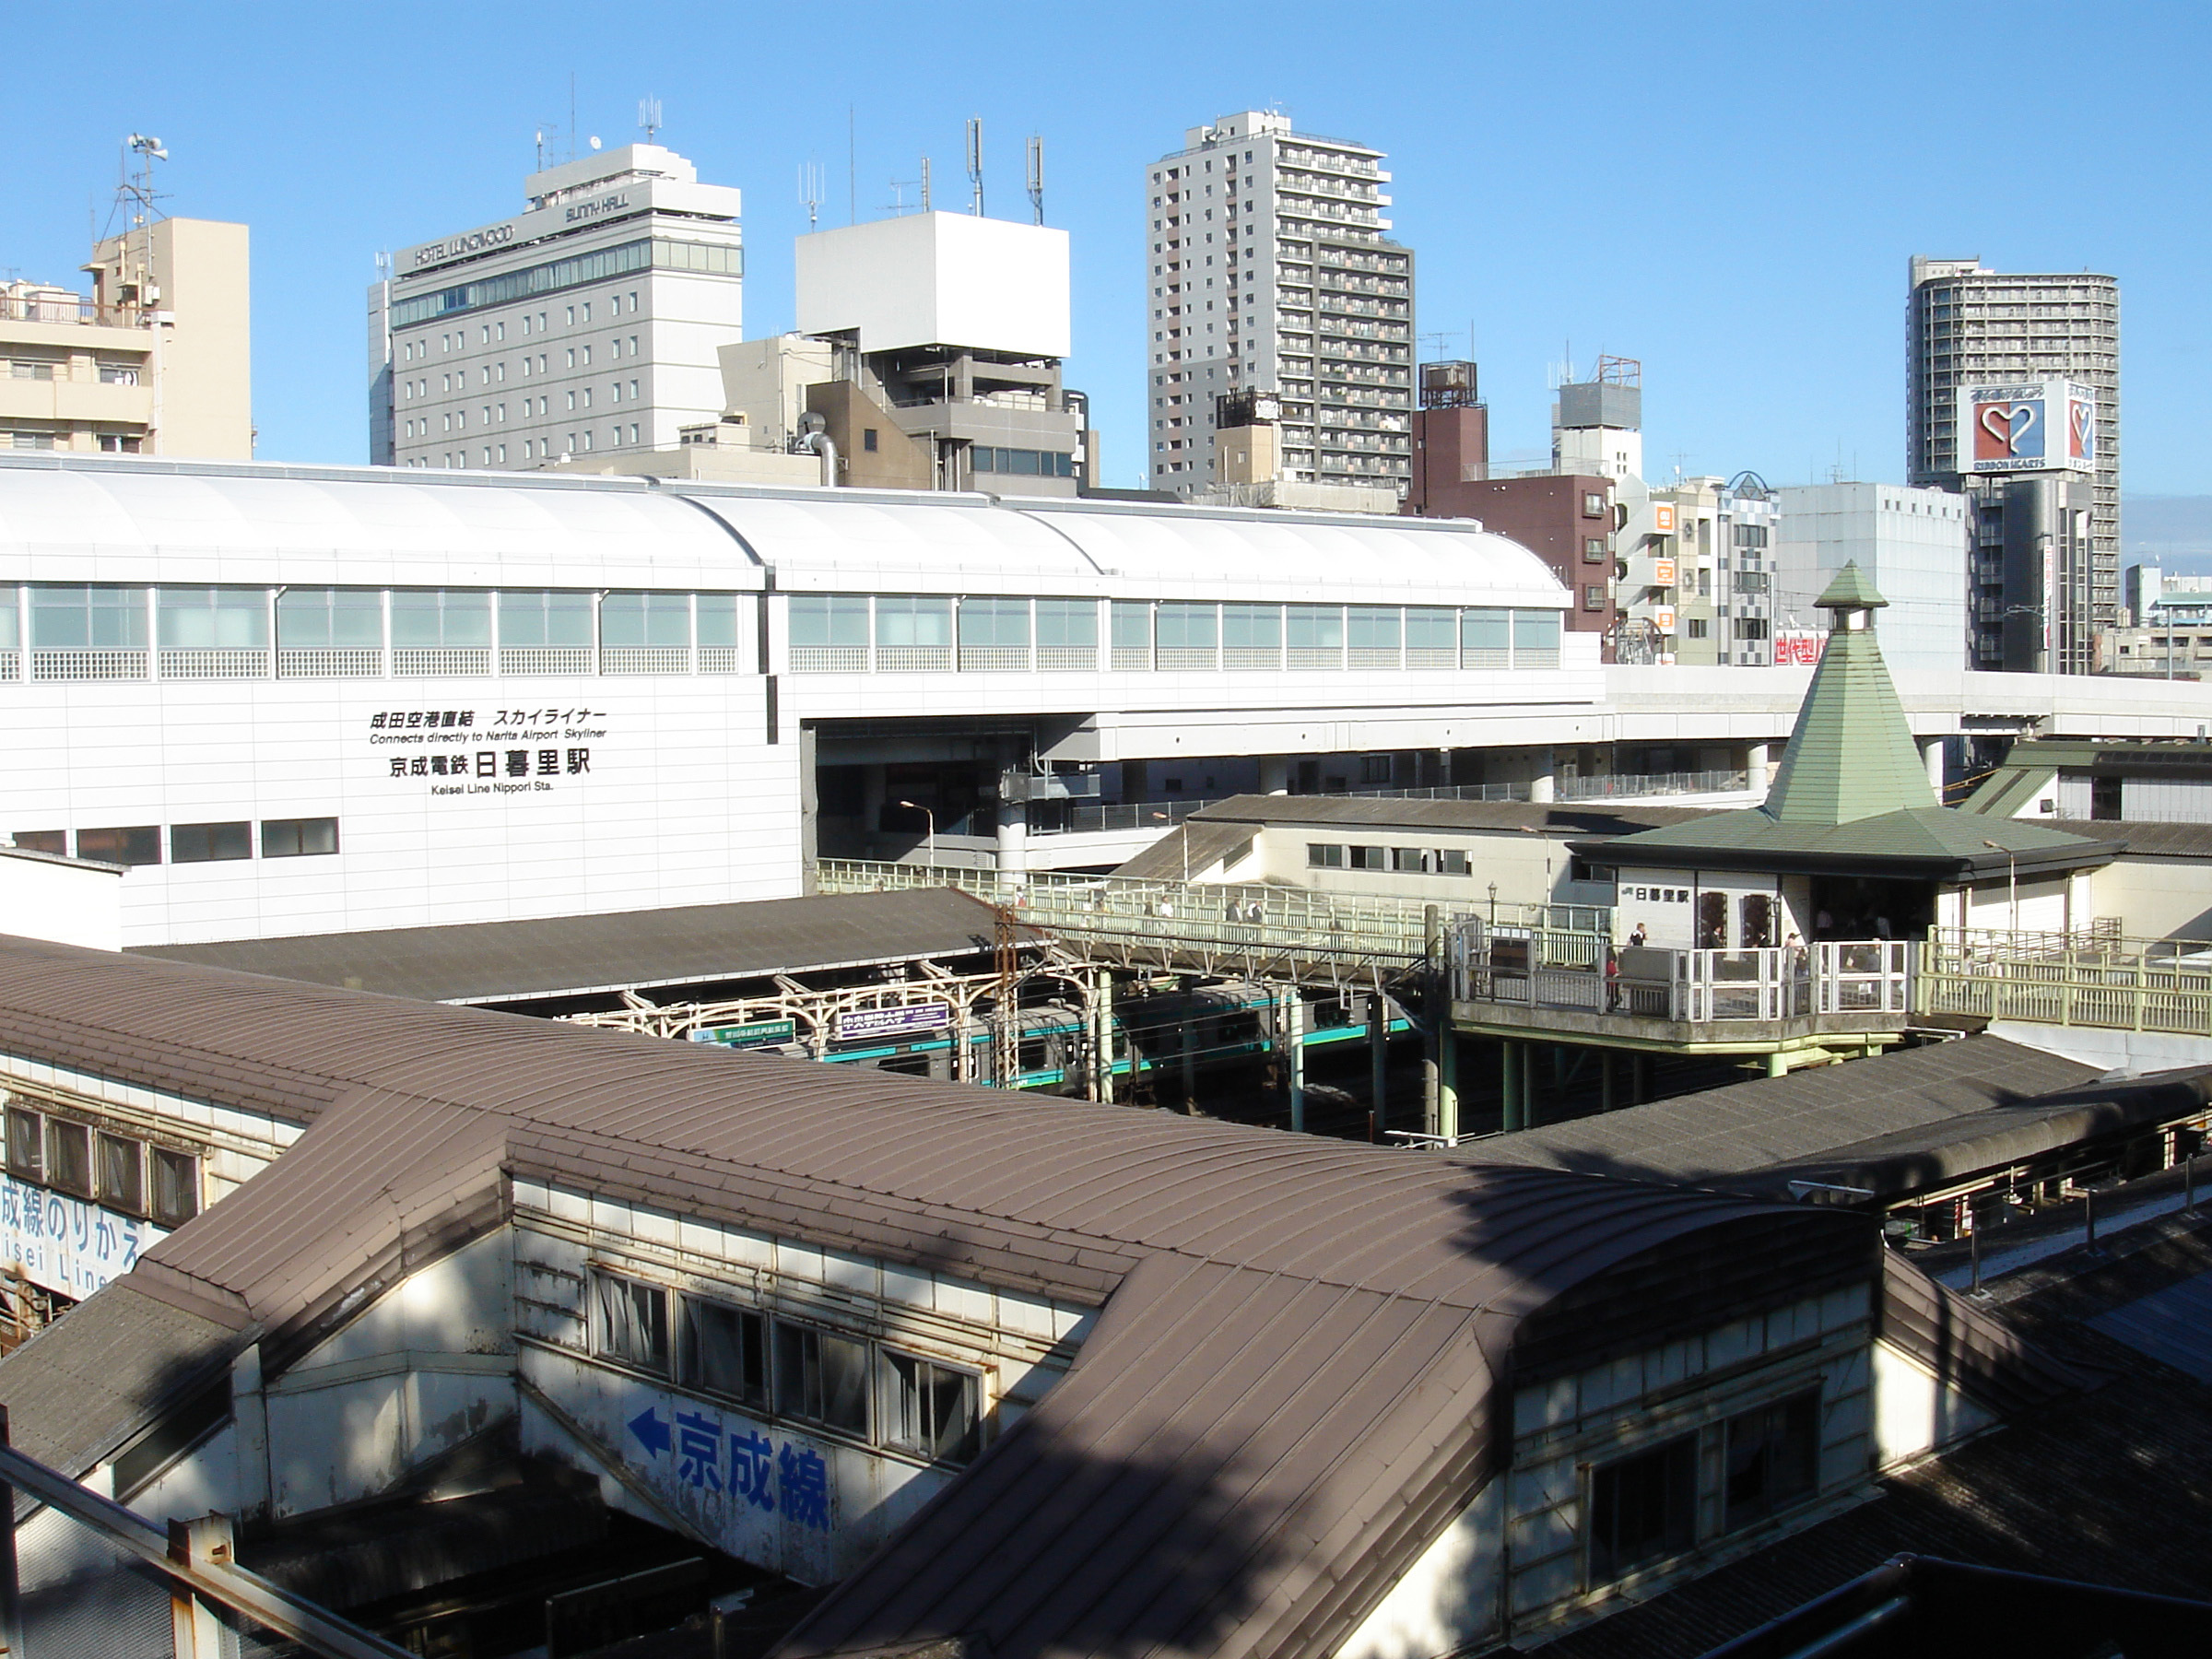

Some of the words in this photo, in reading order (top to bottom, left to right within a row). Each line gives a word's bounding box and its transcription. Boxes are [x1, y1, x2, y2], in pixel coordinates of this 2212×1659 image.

[566, 205, 599, 223] SUNNY
[602, 194, 629, 214] HALL
[415, 244, 448, 267] HOTEL
[1973, 460, 2009, 472] RIBBON
[2011, 458, 2046, 470] HEARTS
[370, 710, 475, 729] 成田空港直結
[493, 708, 607, 725] スカイライナー
[370, 734, 424, 745] Connects
[428, 732, 469, 744] directly
[472, 733, 483, 742] to
[486, 730, 518, 741] Narita
[521, 729, 559, 741] Airport
[564, 728, 607, 741] Skyliner
[431, 783, 465, 795] Keisei
[467, 783, 490, 794] Line
[493, 782, 532, 794] Nippori
[534, 781, 554, 792] Sta.
[1636, 887, 1689, 903] 日暮里駅
[59, 1253, 107, 1291] Line
[677, 1411, 829, 1534] 京成線
